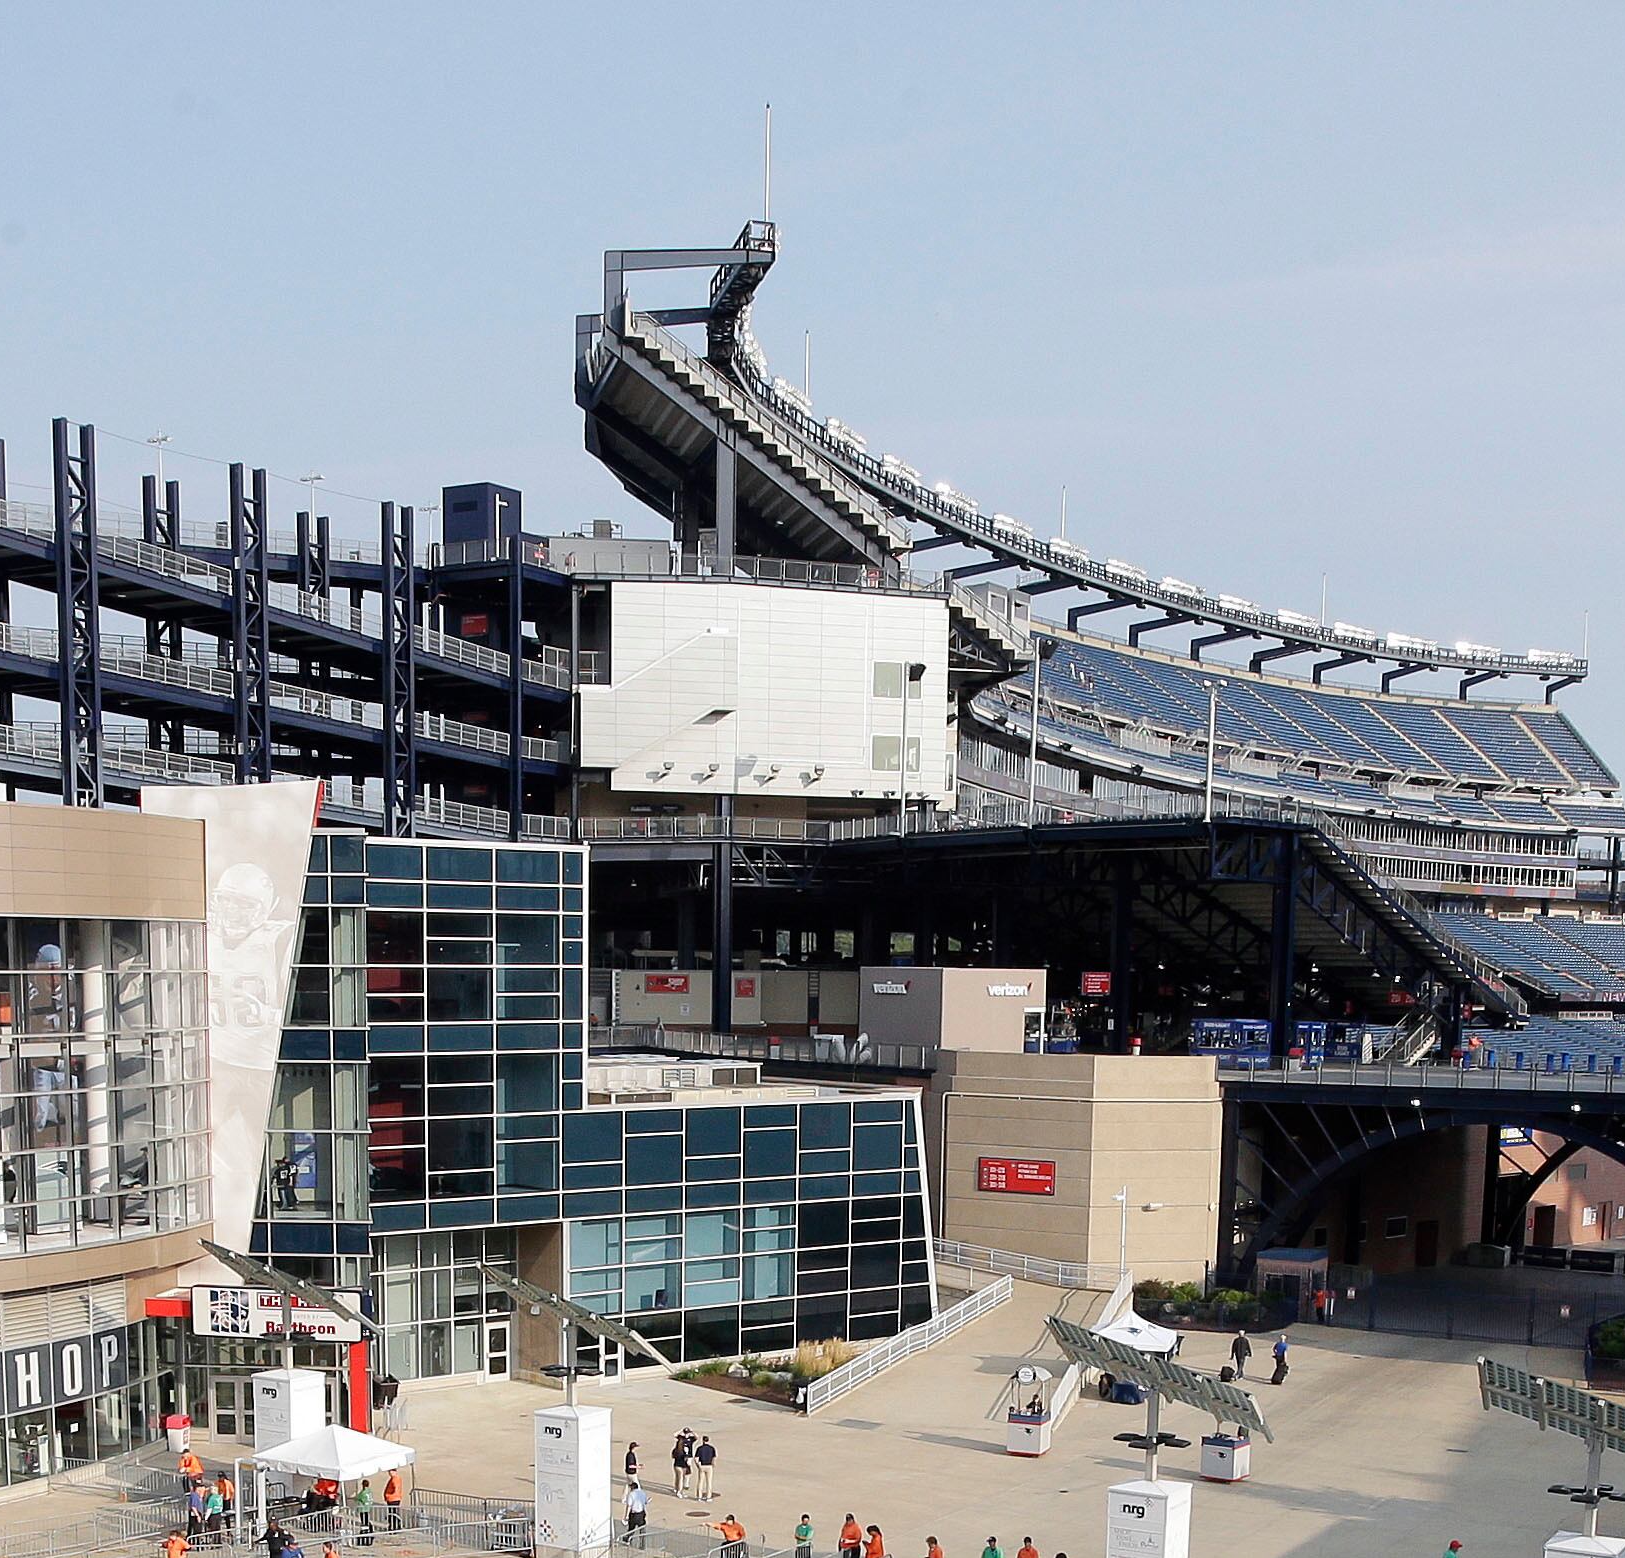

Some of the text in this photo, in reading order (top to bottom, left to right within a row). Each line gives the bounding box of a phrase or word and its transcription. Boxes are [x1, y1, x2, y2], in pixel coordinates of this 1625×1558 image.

[872, 980, 907, 994] verizon
[987, 982, 1029, 996] verizon
[262, 1387, 277, 1398] nrg
[544, 1425, 562, 1438] nrg
[1122, 1503, 1145, 1518] nrg
